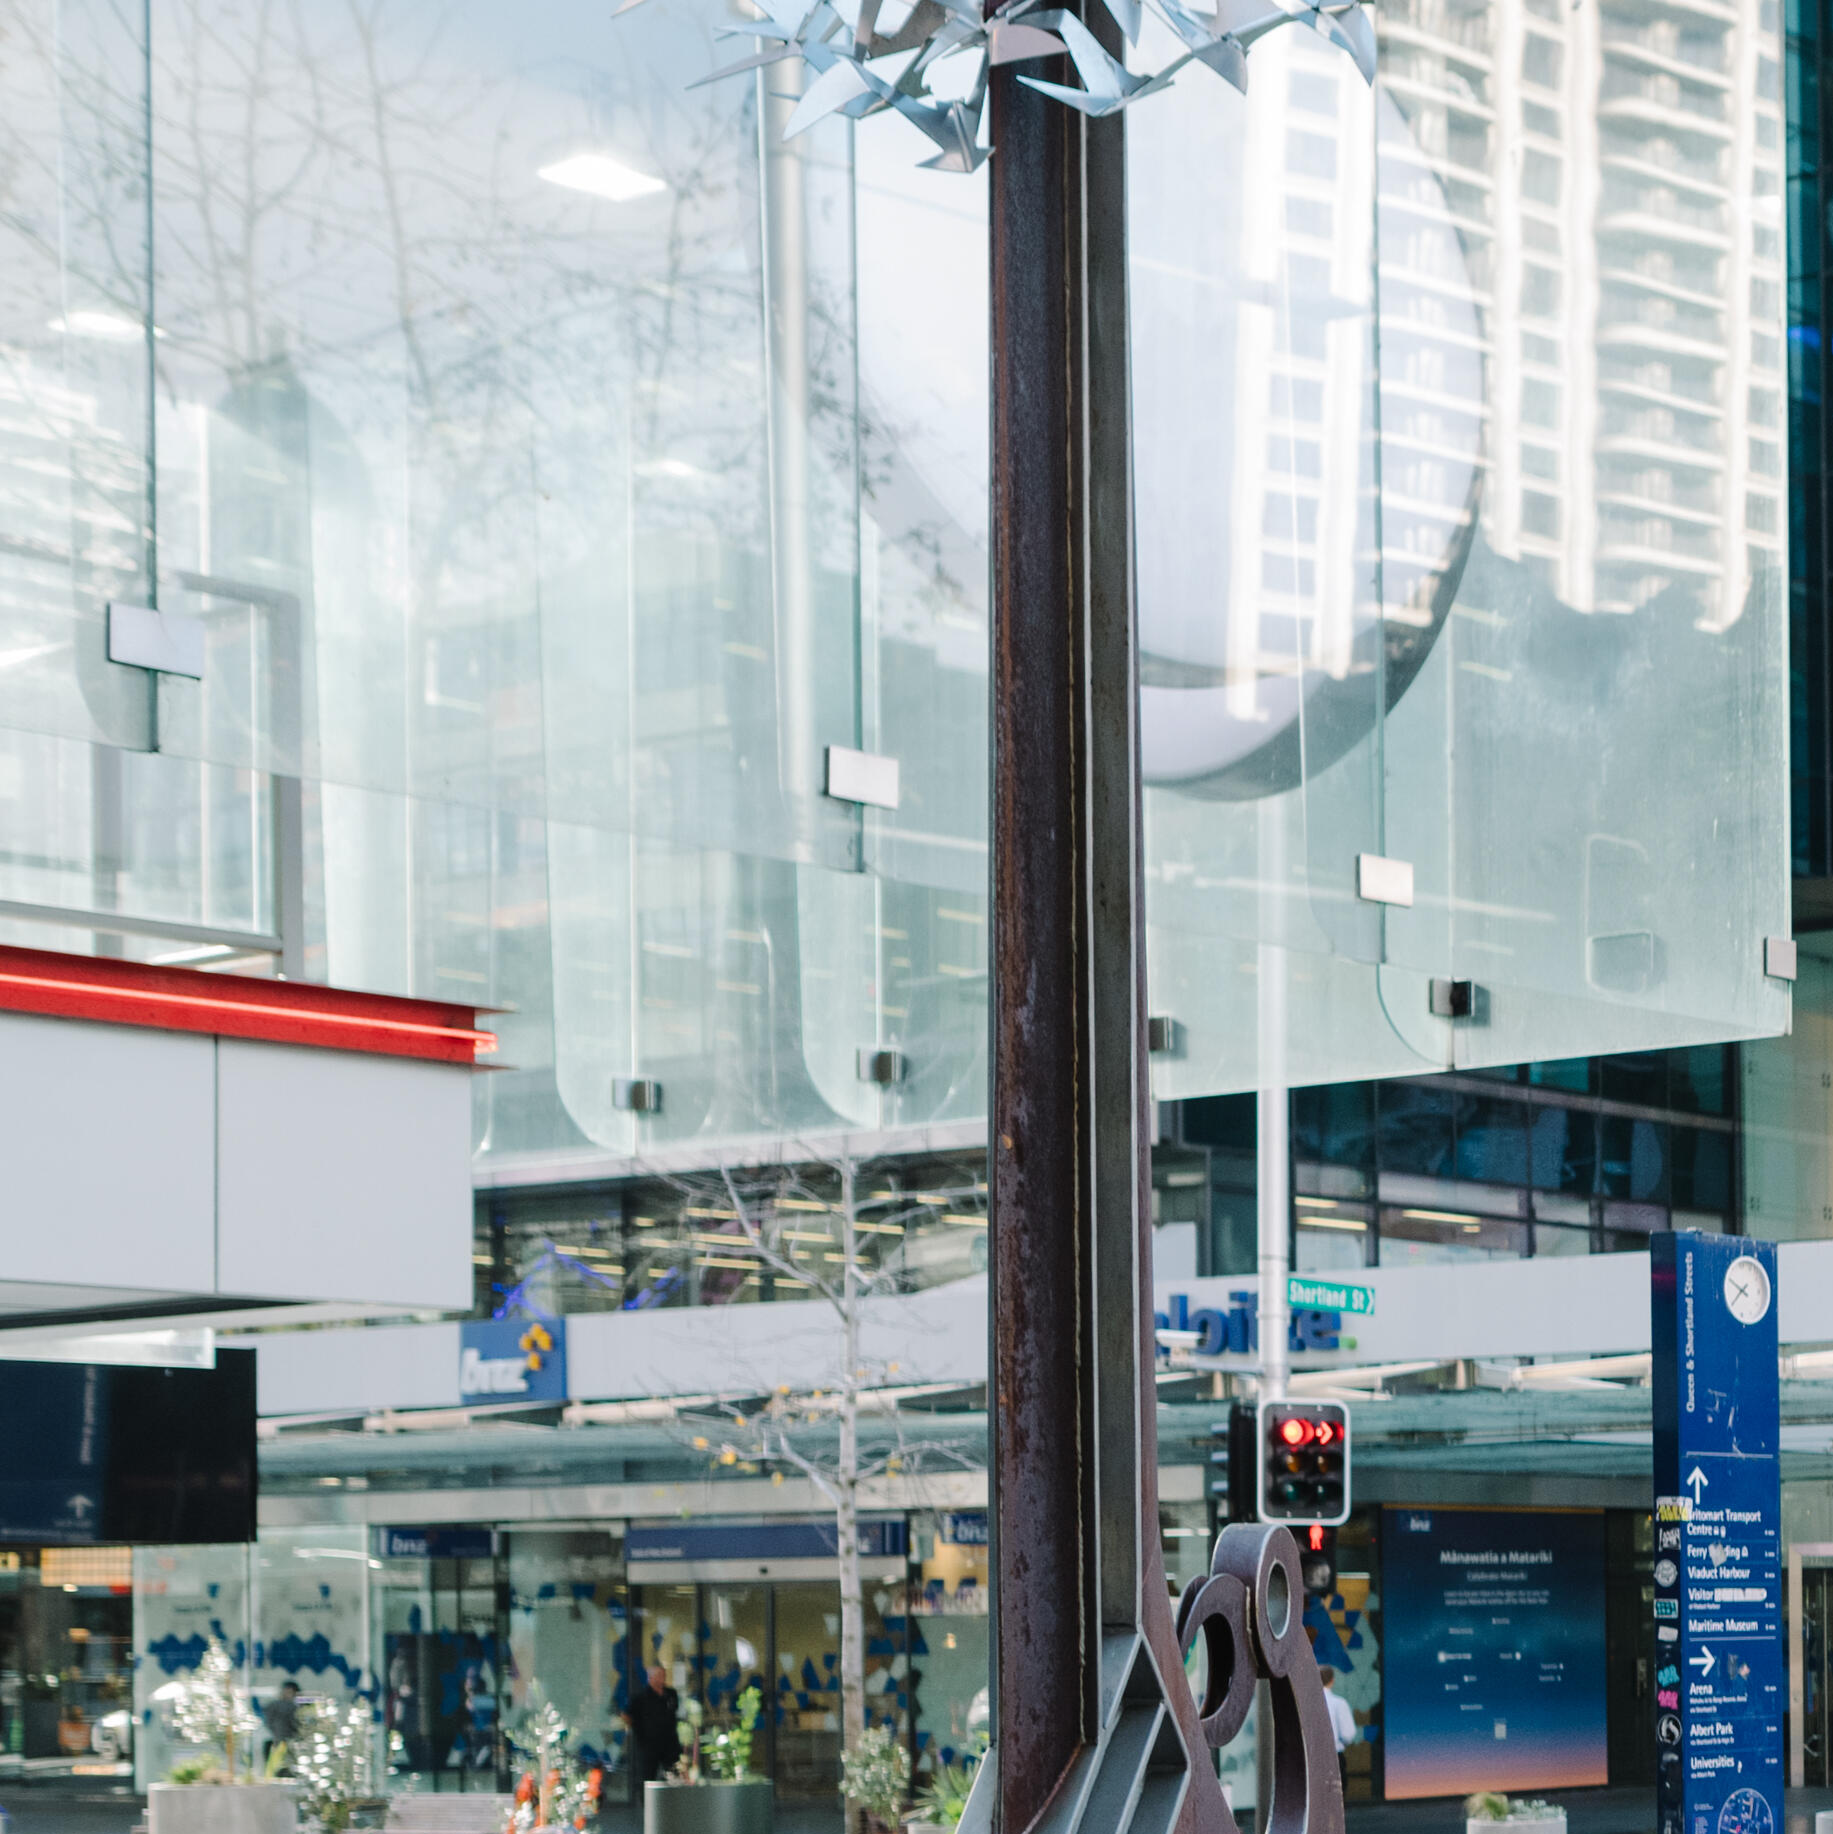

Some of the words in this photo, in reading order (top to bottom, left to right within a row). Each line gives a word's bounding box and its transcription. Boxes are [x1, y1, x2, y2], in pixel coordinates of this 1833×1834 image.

[1685, 1251, 1694, 1295] Streets
[1289, 1280, 1347, 1309] Shortland
[1352, 1289, 1365, 1311] St
[1685, 1297, 1695, 1357] Shortland
[461, 1348, 531, 1395] bnz
[1685, 1359, 1695, 1371] &
[1686, 1373, 1695, 1413] Queen
[1690, 1510, 1724, 1522] ritomart
[1725, 1508, 1761, 1525] Transport
[1687, 1523, 1712, 1536] Centre
[1509, 1550, 1552, 1564] Matariki
[1687, 1544, 1707, 1560] Ferry
[1688, 1566, 1718, 1579] Viaduct
[1719, 1565, 1750, 1579] Harbour
[1688, 1587, 1713, 1601] Visitor
[1688, 1619, 1724, 1632] Maritime
[1725, 1618, 1758, 1632] Museum
[1689, 1682, 1713, 1695] Arena
[1690, 1724, 1714, 1736] Albert
[1715, 1722, 1733, 1735] Park
[1690, 1755, 1734, 1769] Universities
